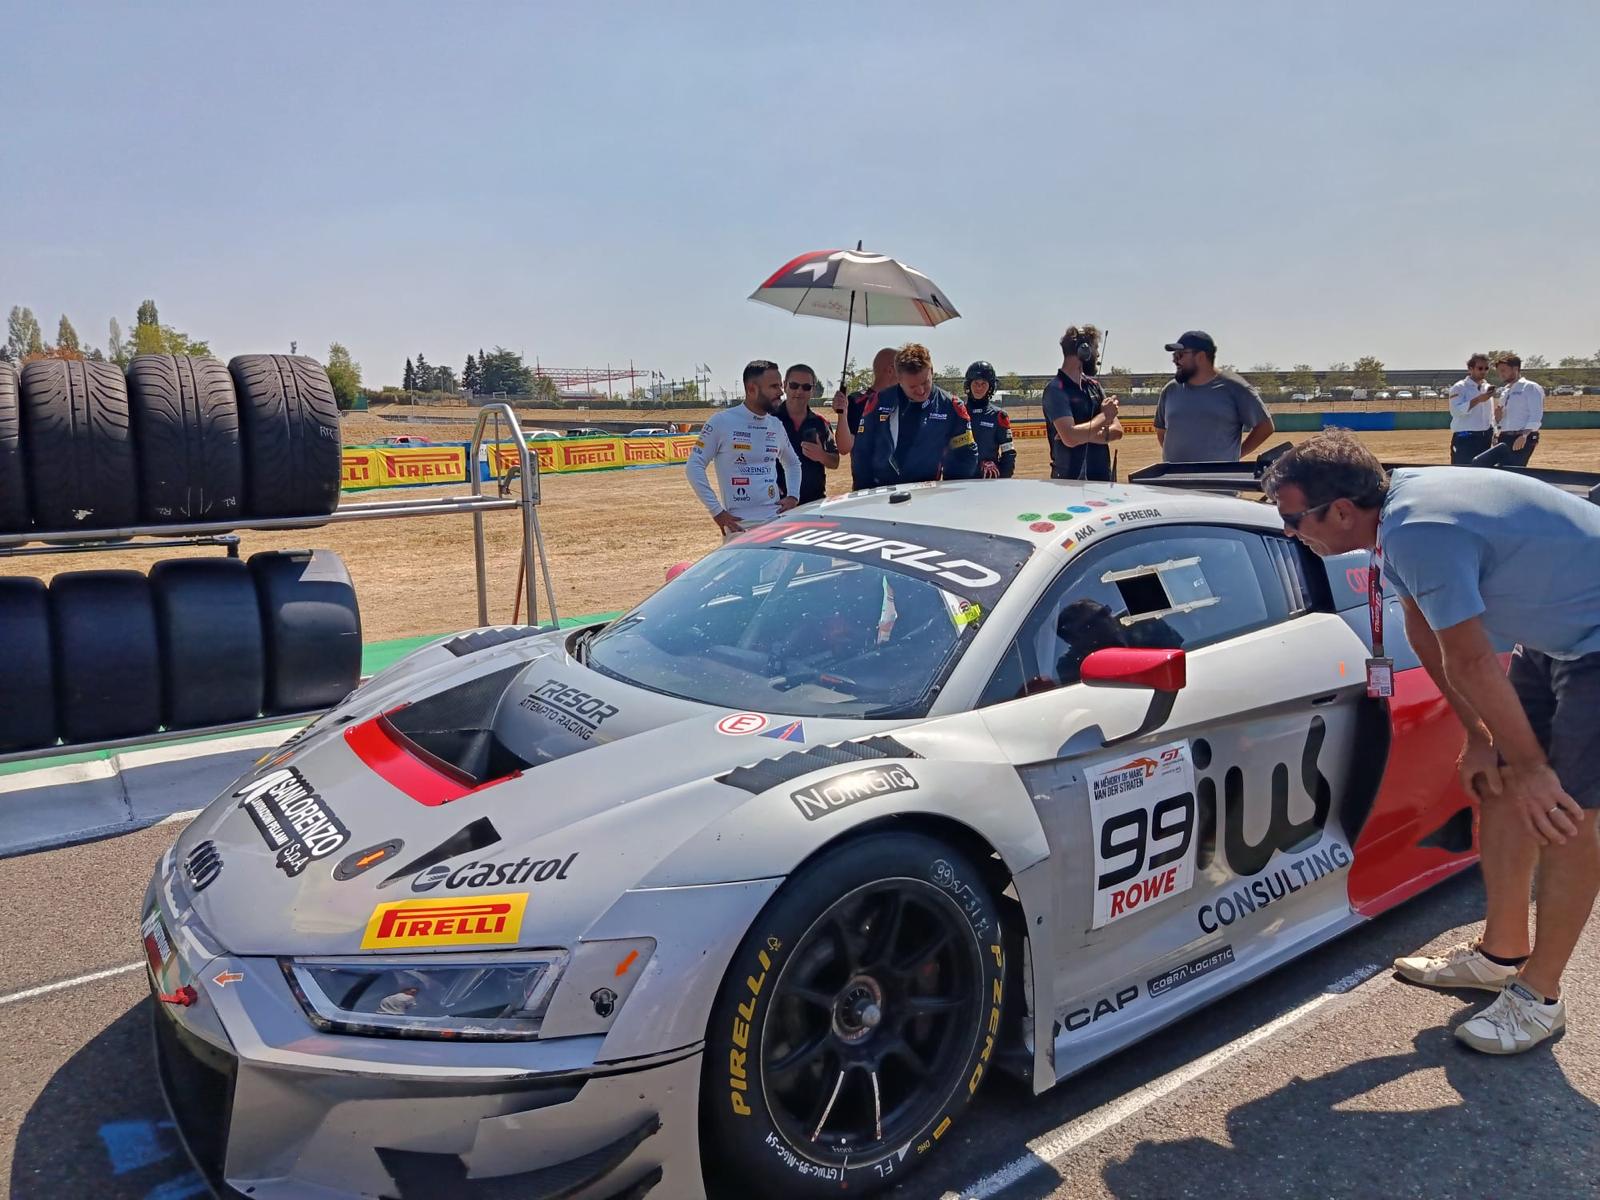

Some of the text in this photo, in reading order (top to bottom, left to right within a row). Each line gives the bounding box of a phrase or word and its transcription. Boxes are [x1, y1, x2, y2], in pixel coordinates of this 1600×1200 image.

[385, 452, 461, 478] PIRELLI
[563, 443, 615, 465] PIRELLI
[1074, 524, 1096, 542] AKA
[1118, 508, 1162, 522] PEREIRA
[781, 529, 1001, 588] WORLD
[519, 698, 594, 741] ATTEMPTO RACING
[535, 679, 620, 725] TRESOR
[1093, 780, 1100, 791] IN
[1128, 767, 1144, 780] MARC
[1094, 779, 1144, 801] VAN DER STRATEN
[268, 777, 344, 856] SANLORENZO
[1097, 791, 1195, 891] 99
[445, 852, 579, 890] Castrol
[1197, 843, 1350, 934] CONSULTING
[1110, 867, 1177, 918] ROWE
[376, 903, 511, 938] PIRELLI
[1152, 949, 1233, 991] COBRA LOGISTIC
[729, 950, 773, 1116] PIRELLI
[967, 978, 1004, 1095] ZERO
[874, 1160, 893, 1178] FL
